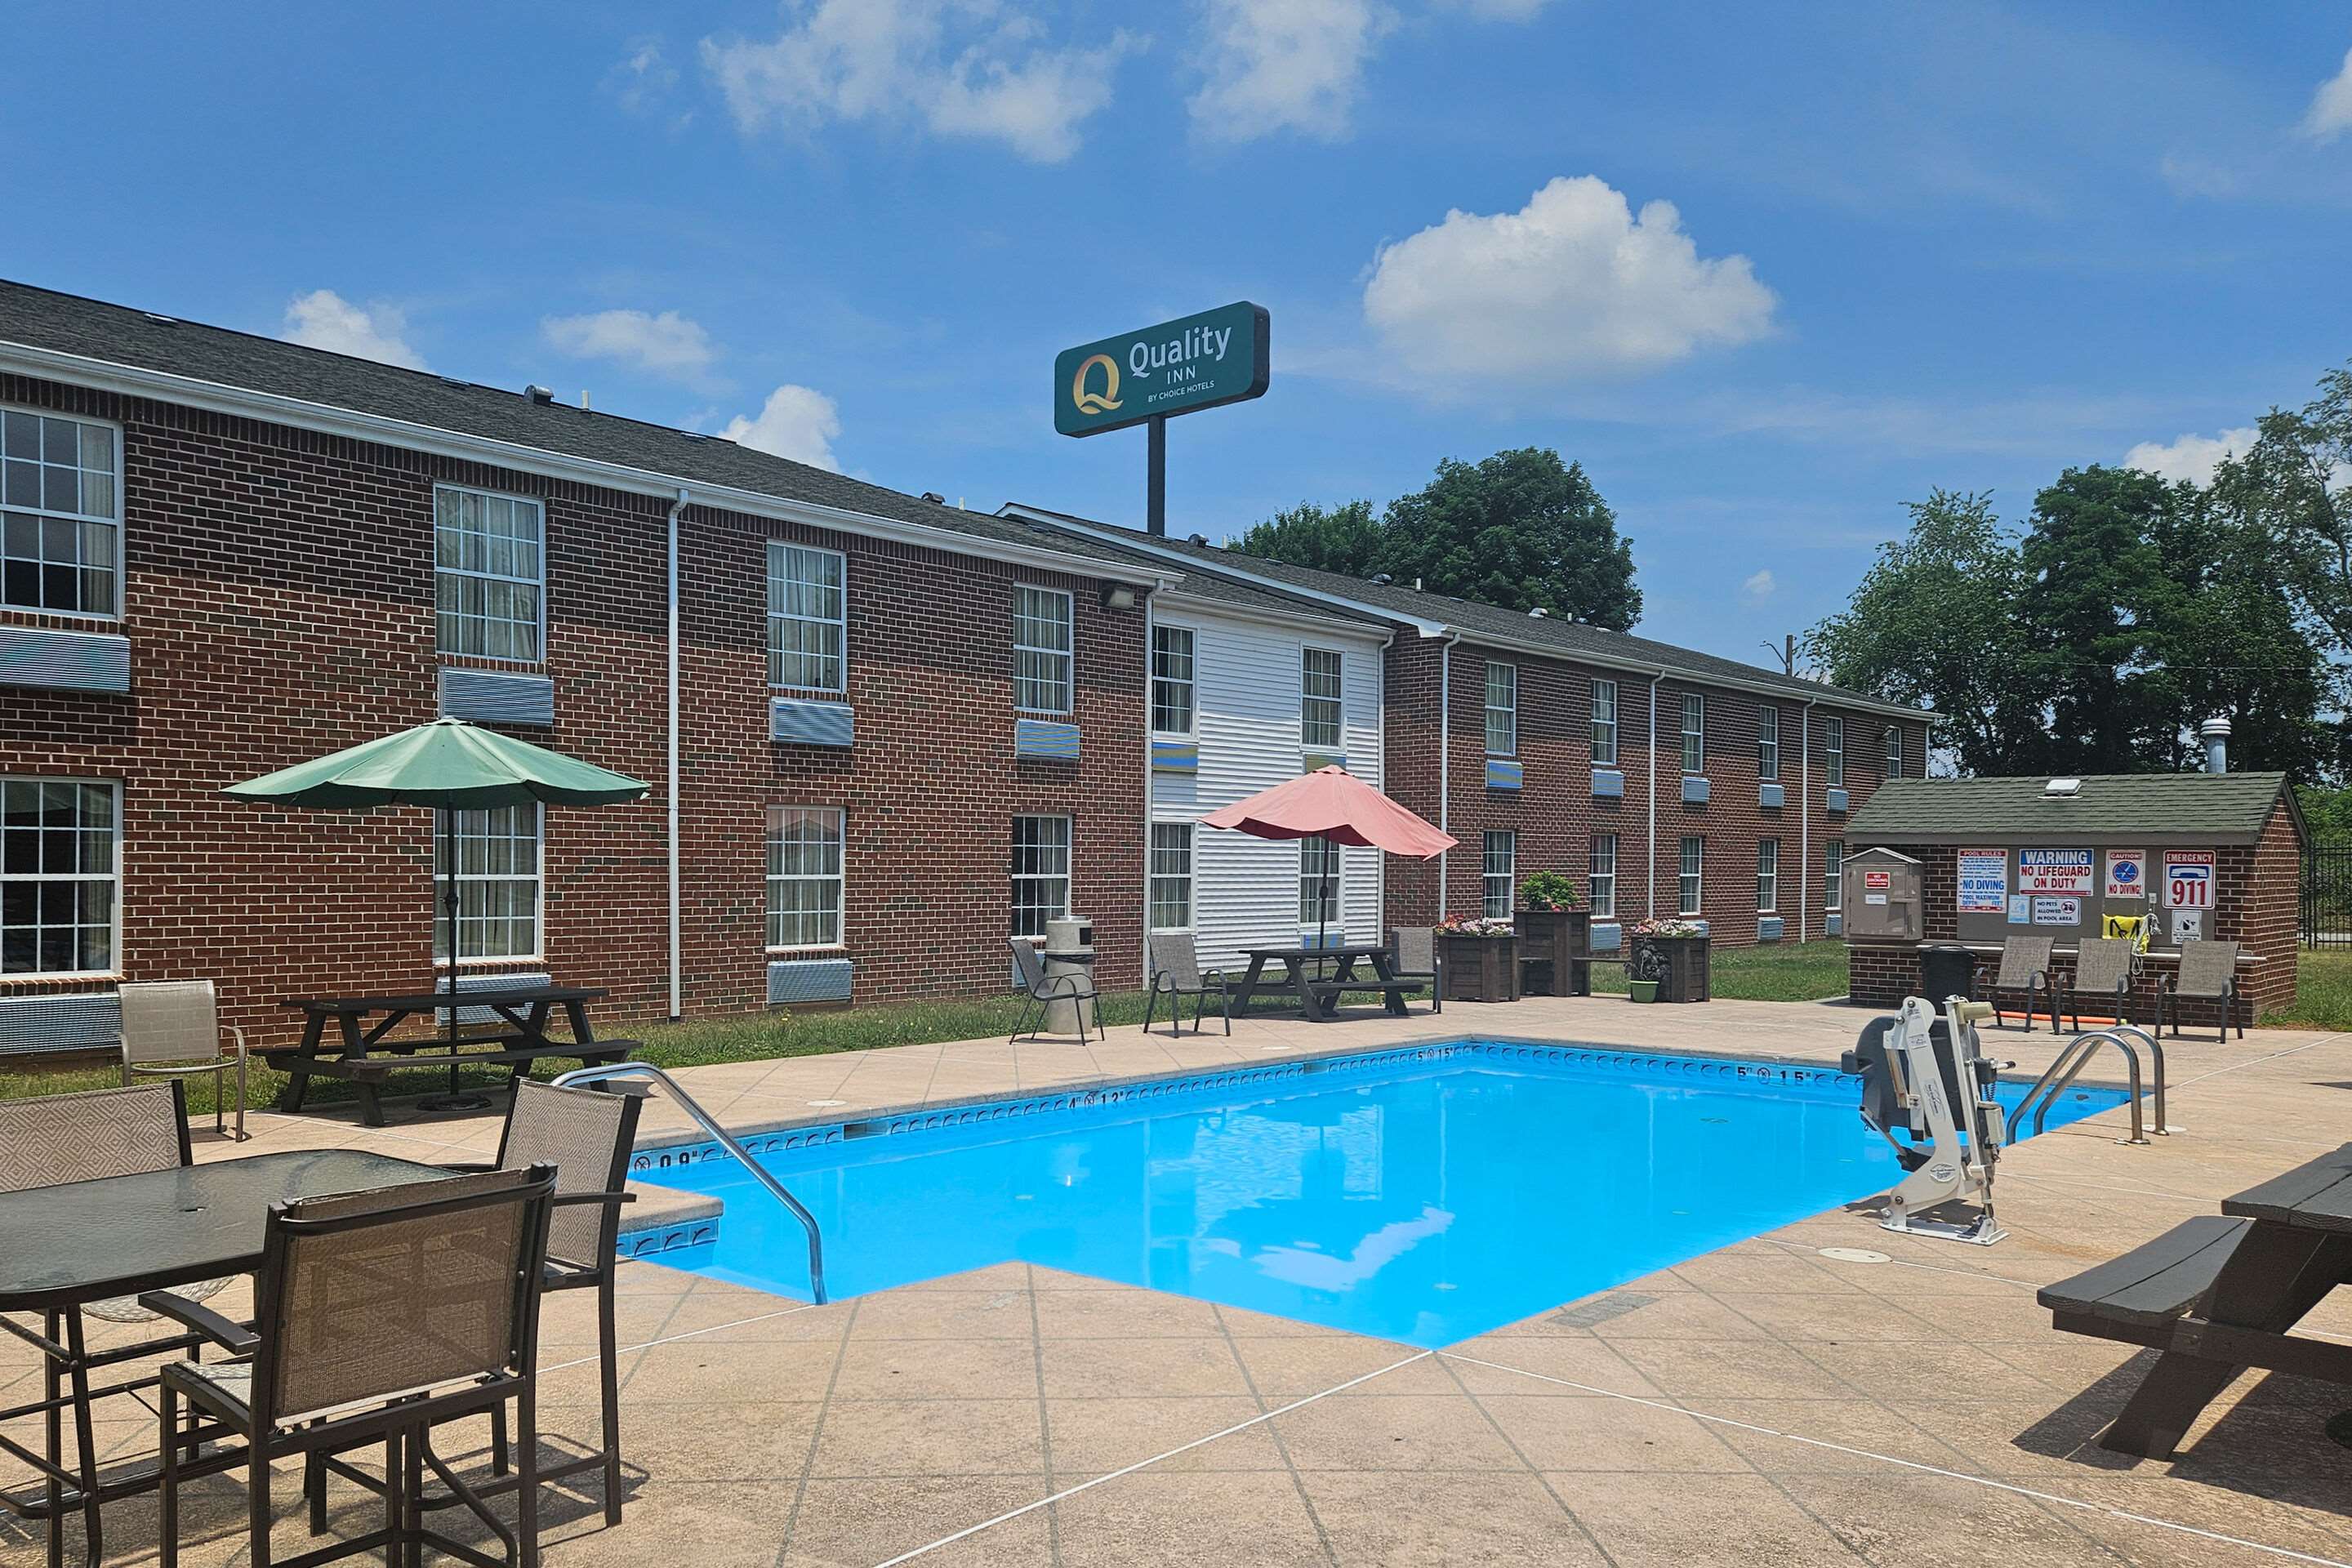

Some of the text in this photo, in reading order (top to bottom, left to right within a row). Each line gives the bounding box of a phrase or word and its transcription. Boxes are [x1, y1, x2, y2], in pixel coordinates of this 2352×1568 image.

[1129, 326, 1232, 378] Quality
[1167, 365, 1196, 385] INN
[1073, 354, 1124, 415] Q
[1148, 380, 1215, 403] BY CHOICE HOTELS
[2025, 851, 2087, 864] WARNING
[2167, 853, 2212, 862] EMERGENCY
[2021, 866, 2091, 876] NO LIFEGUARD
[1963, 880, 2004, 890] NO DIVING
[2034, 878, 2076, 889] ON DUTY
[2109, 884, 2117, 893] NO
[2172, 880, 2205, 905] 911
